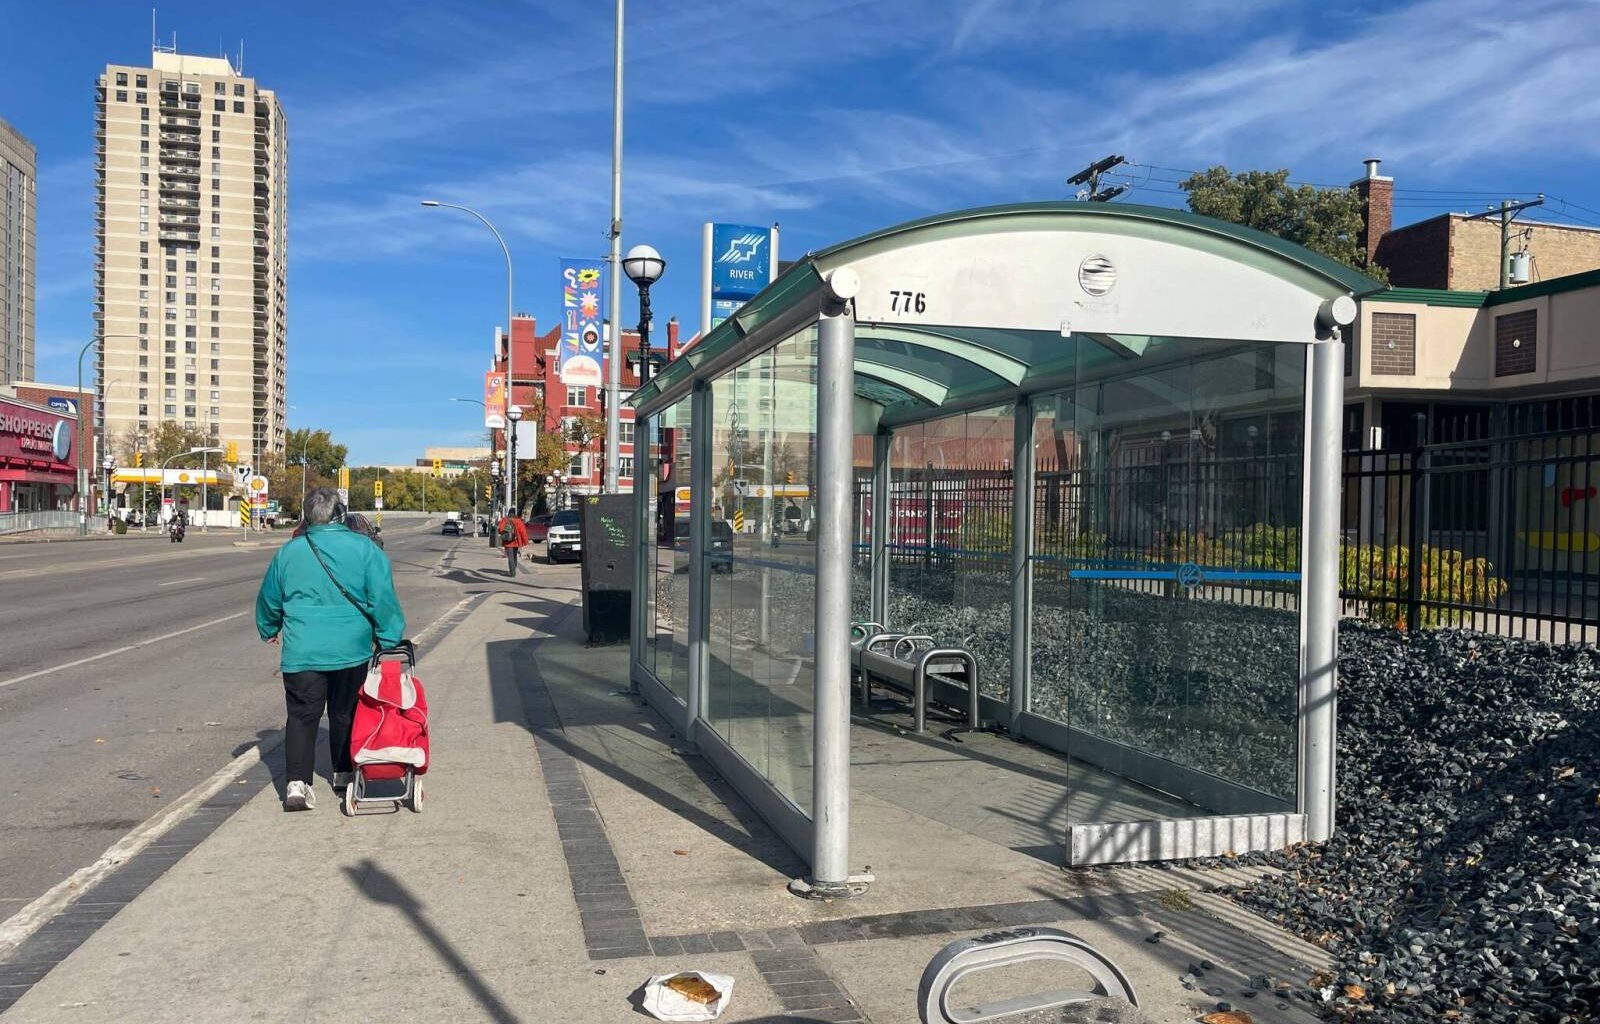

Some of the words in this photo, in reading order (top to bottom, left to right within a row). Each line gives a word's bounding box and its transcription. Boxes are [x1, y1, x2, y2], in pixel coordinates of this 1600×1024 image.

[729, 269, 754, 280] RIVER
[889, 290, 926, 314] 776
[0, 413, 53, 439] SHOPPERS
